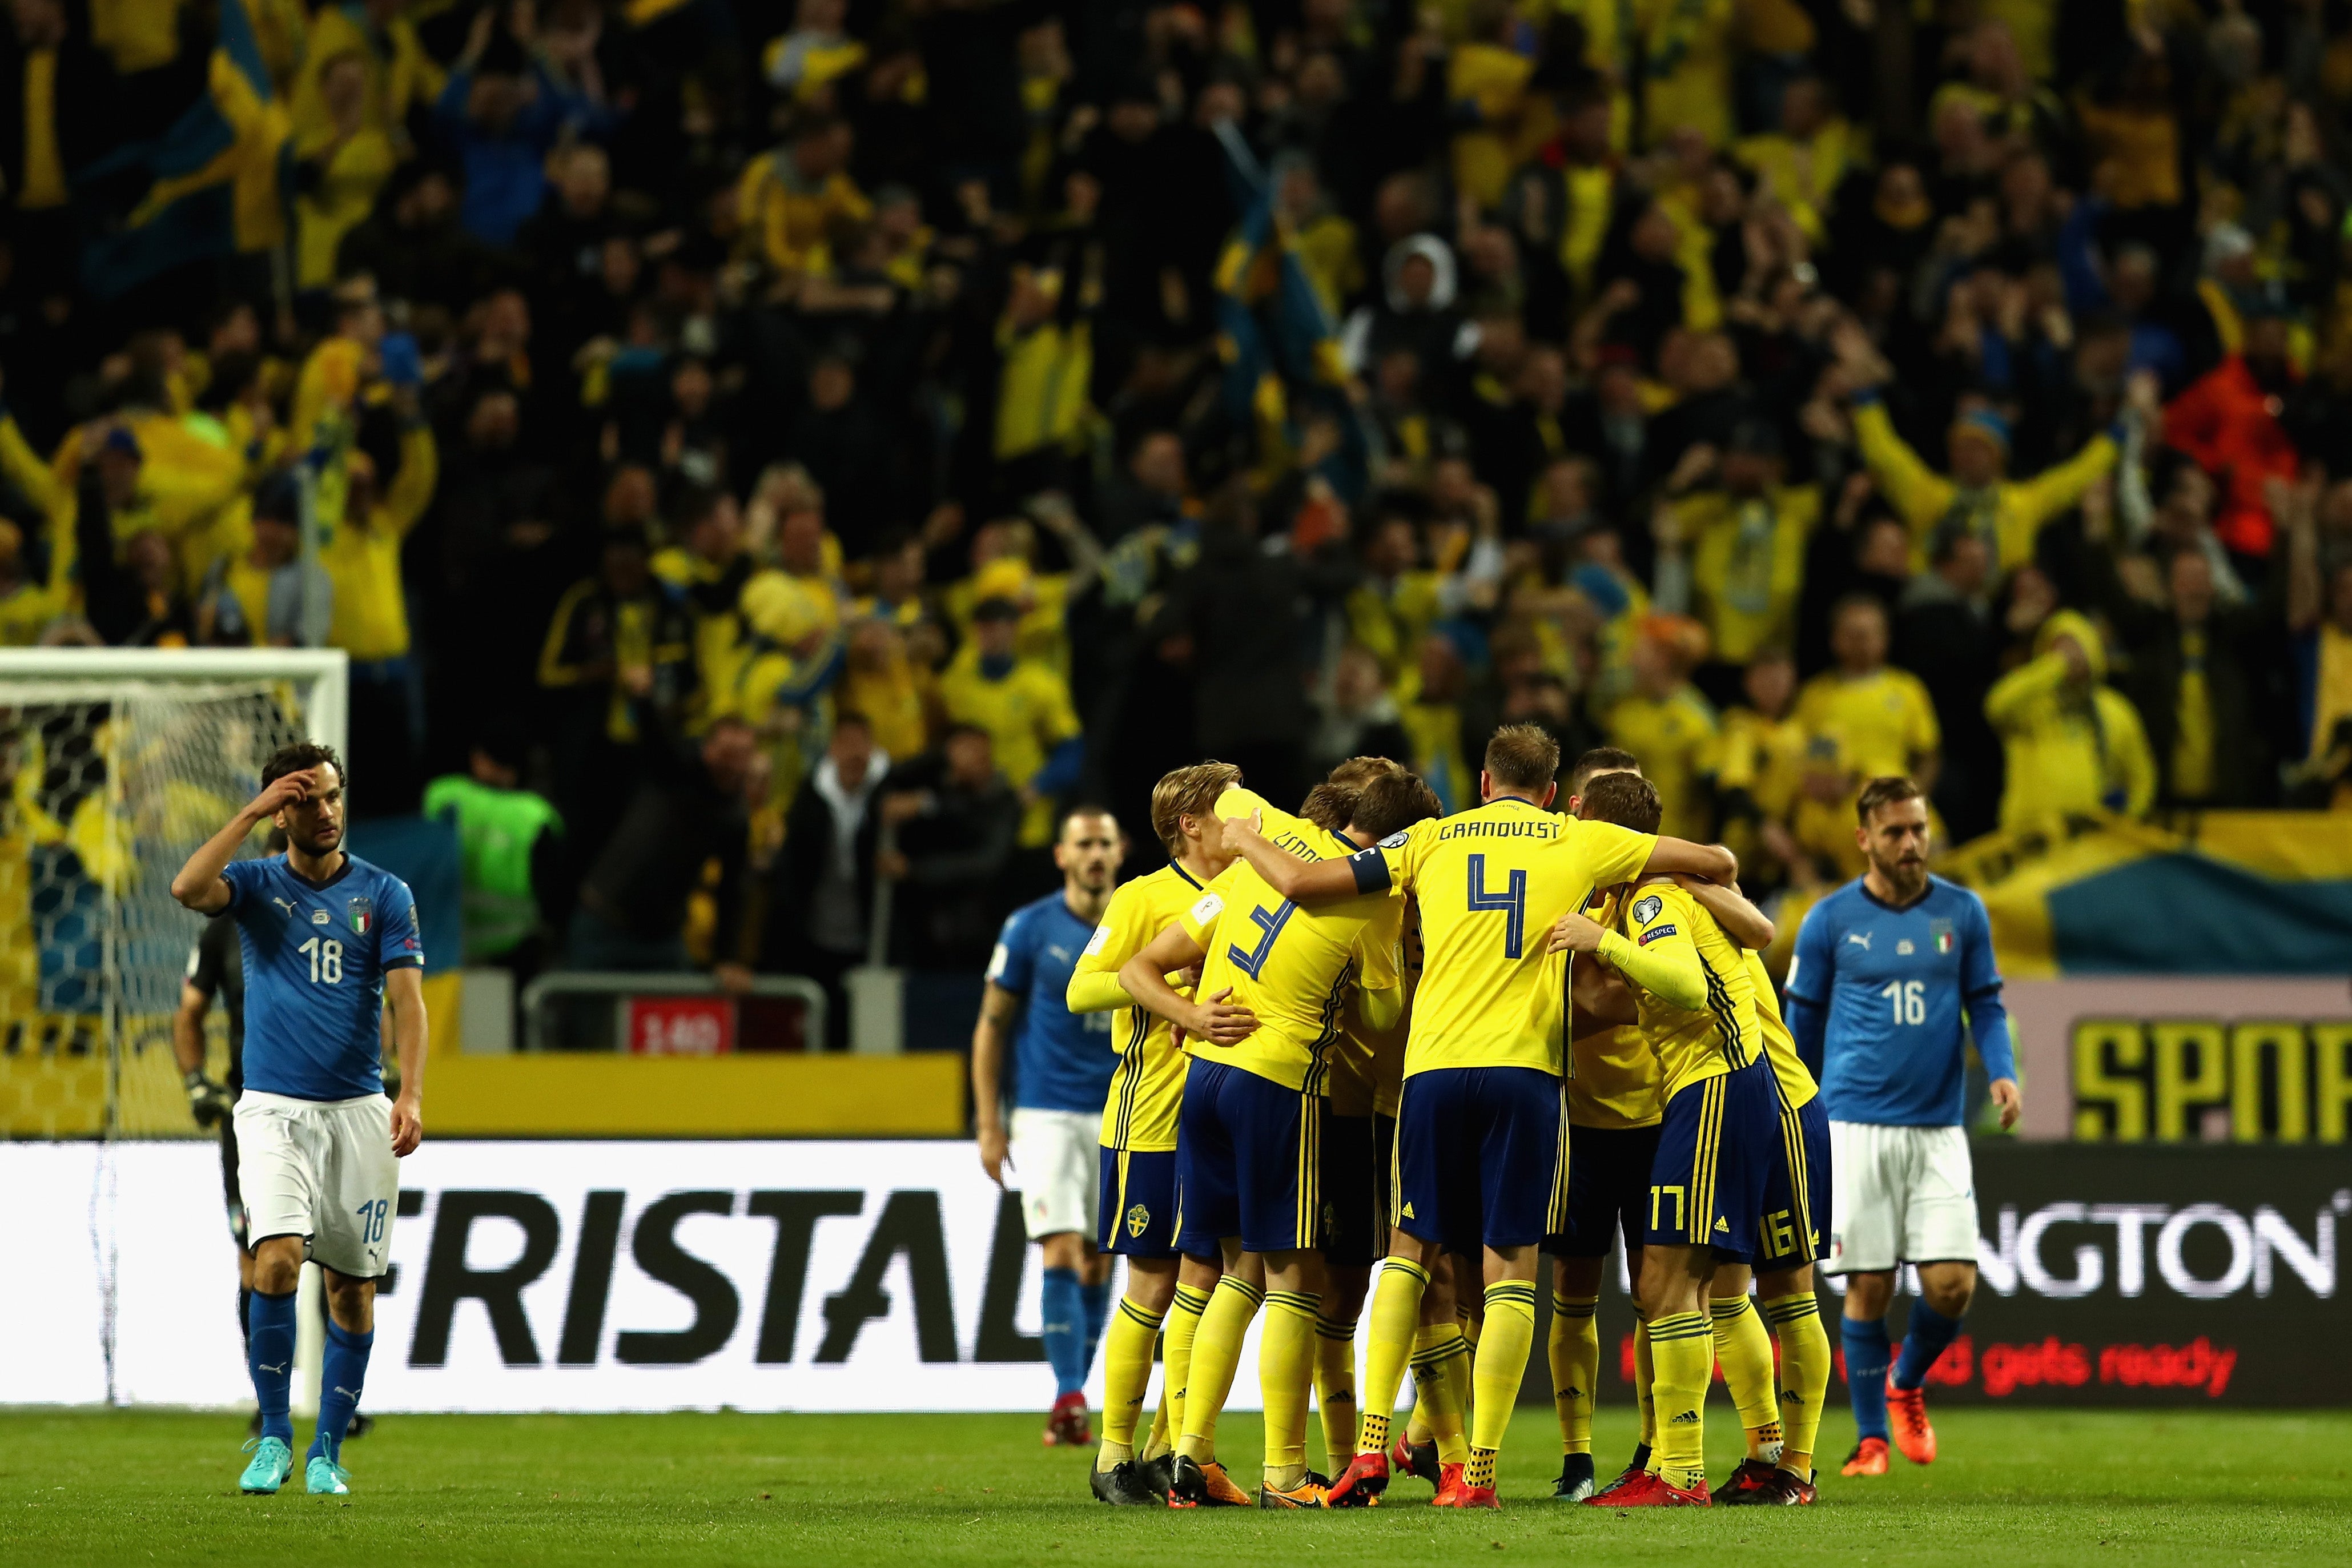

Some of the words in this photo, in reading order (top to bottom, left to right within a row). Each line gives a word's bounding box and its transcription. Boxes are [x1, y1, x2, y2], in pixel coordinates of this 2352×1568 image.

[1439, 821, 1560, 841] GRANQVIST
[1468, 854, 1527, 959] 4
[1646, 926, 1675, 940] RESPECT
[298, 936, 344, 984] 18
[1881, 980, 1925, 1026] 16
[357, 1199, 389, 1244] 18
[1650, 1185, 1684, 1231] 17
[1759, 1209, 1798, 1260] 16
